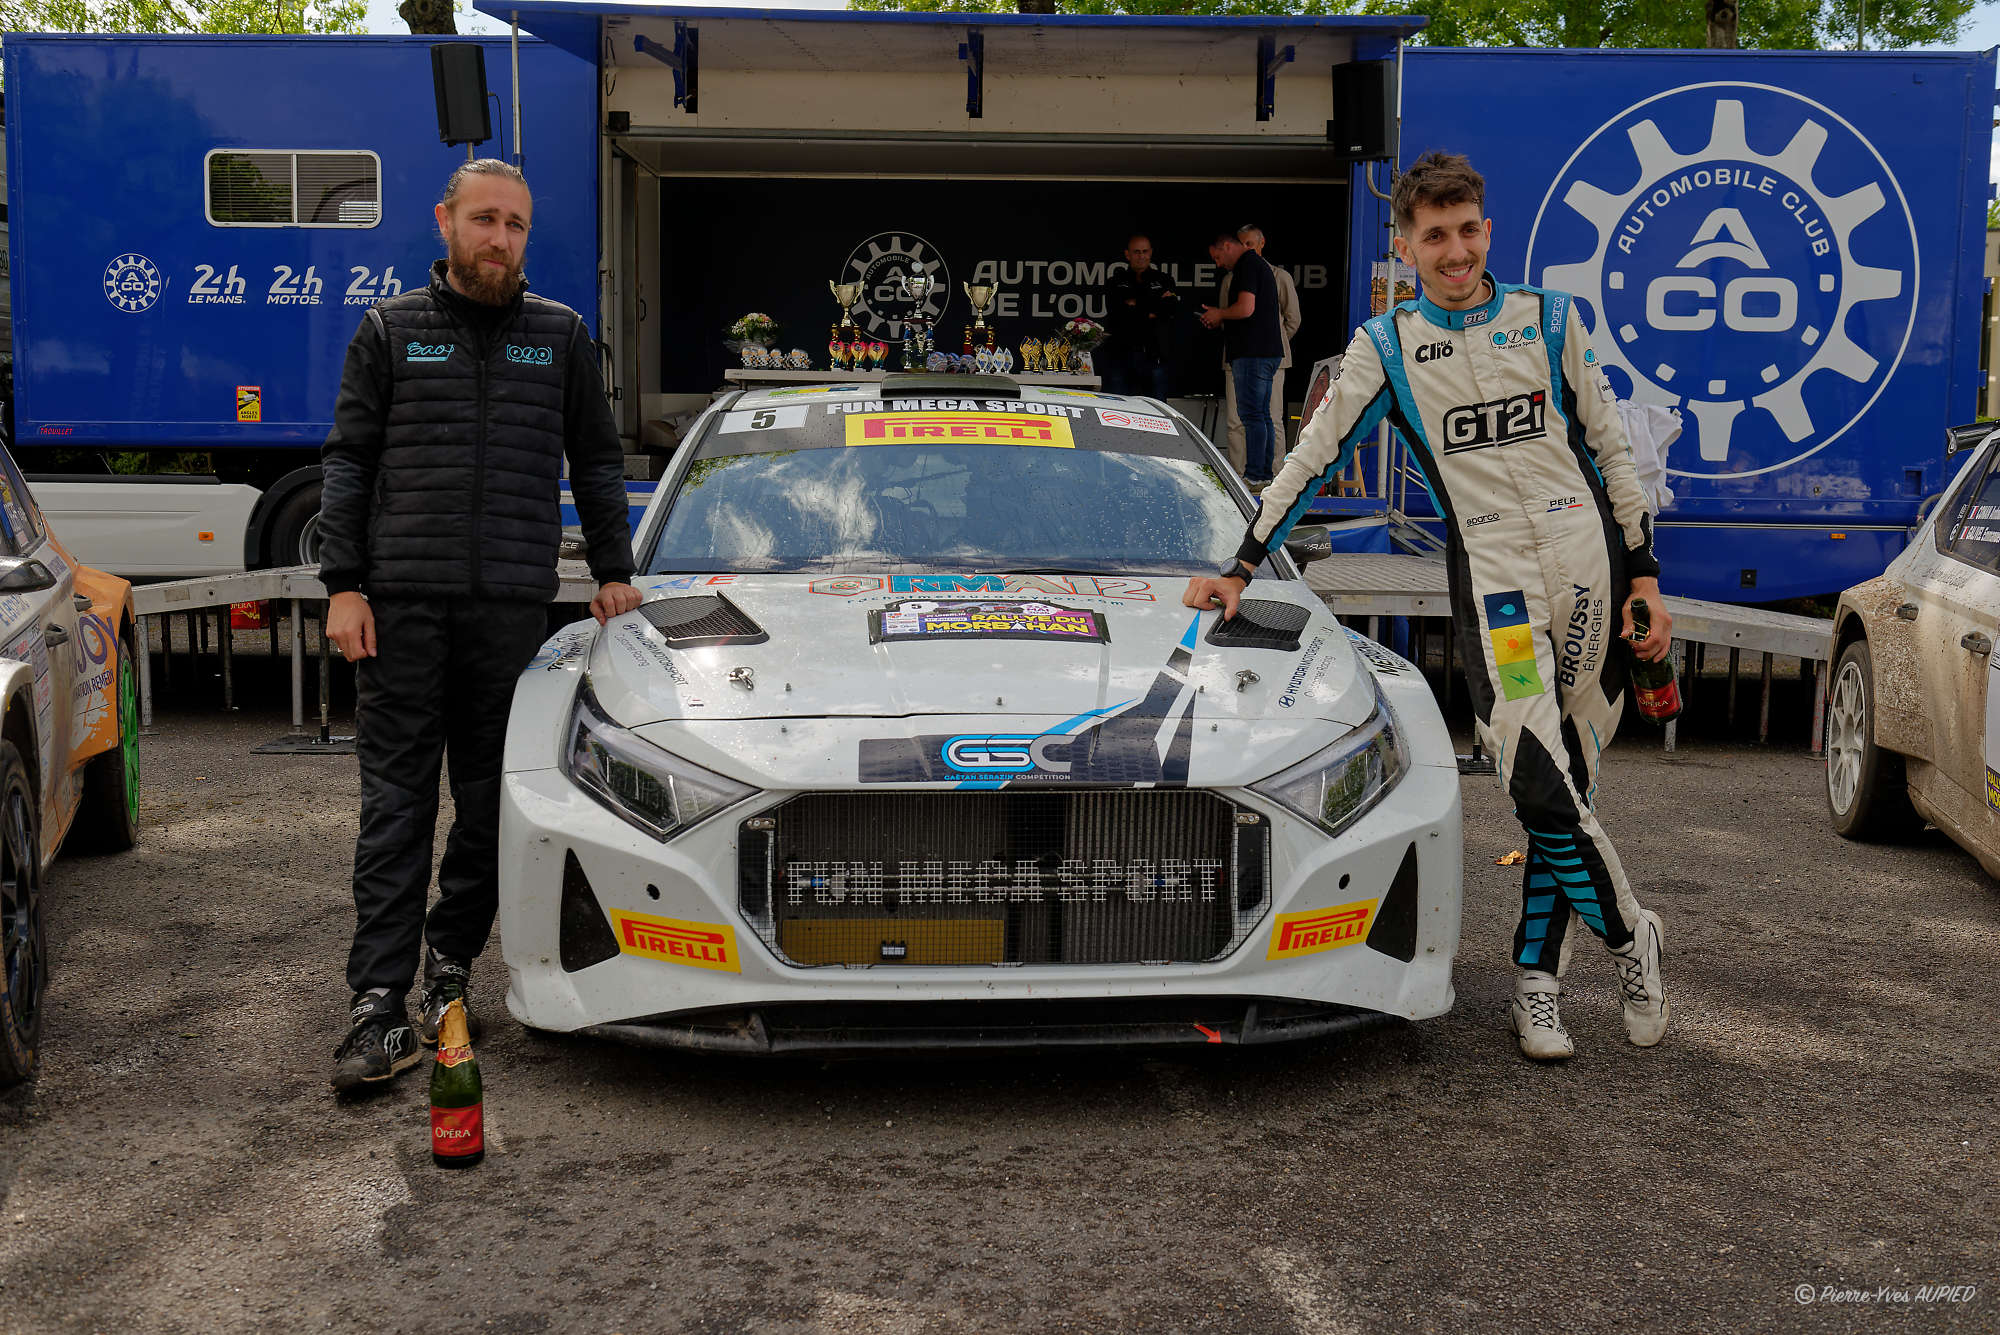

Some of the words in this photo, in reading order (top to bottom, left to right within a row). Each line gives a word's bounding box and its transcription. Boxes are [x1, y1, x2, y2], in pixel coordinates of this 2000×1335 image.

[1618, 168, 1777, 255] AUTOMOBILE
[1782, 191, 1830, 257] CLUB
[190, 264, 246, 294] 24h
[269, 265, 323, 294] 24h
[346, 266, 401, 295] 24h
[188, 295, 203, 304] LE
[1551, 297, 1562, 333] sparco
[1375, 322, 1394, 356] sparco
[1415, 342, 1454, 363] Clio
[751, 409, 777, 430] 5
[826, 400, 884, 415] FUN
[893, 400, 979, 412] MECA
[986, 401, 1085, 419] SPORT
[1446, 393, 1544, 445] GT2i
[864, 416, 1053, 440] PIRELLI
[1550, 497, 1576, 507] PELA
[1467, 513, 1500, 526] sparco
[971, 614, 1052, 622] RALLYE
[1055, 616, 1086, 624] DU
[1560, 584, 1591, 688] BROUSSY
[1583, 600, 1603, 671] ÉNERGIES
[787, 861, 883, 905] FUN
[1057, 858, 1222, 902] SPORT
[620, 918, 728, 963] PIRELLI
[1277, 908, 1369, 952] PIRELLI
